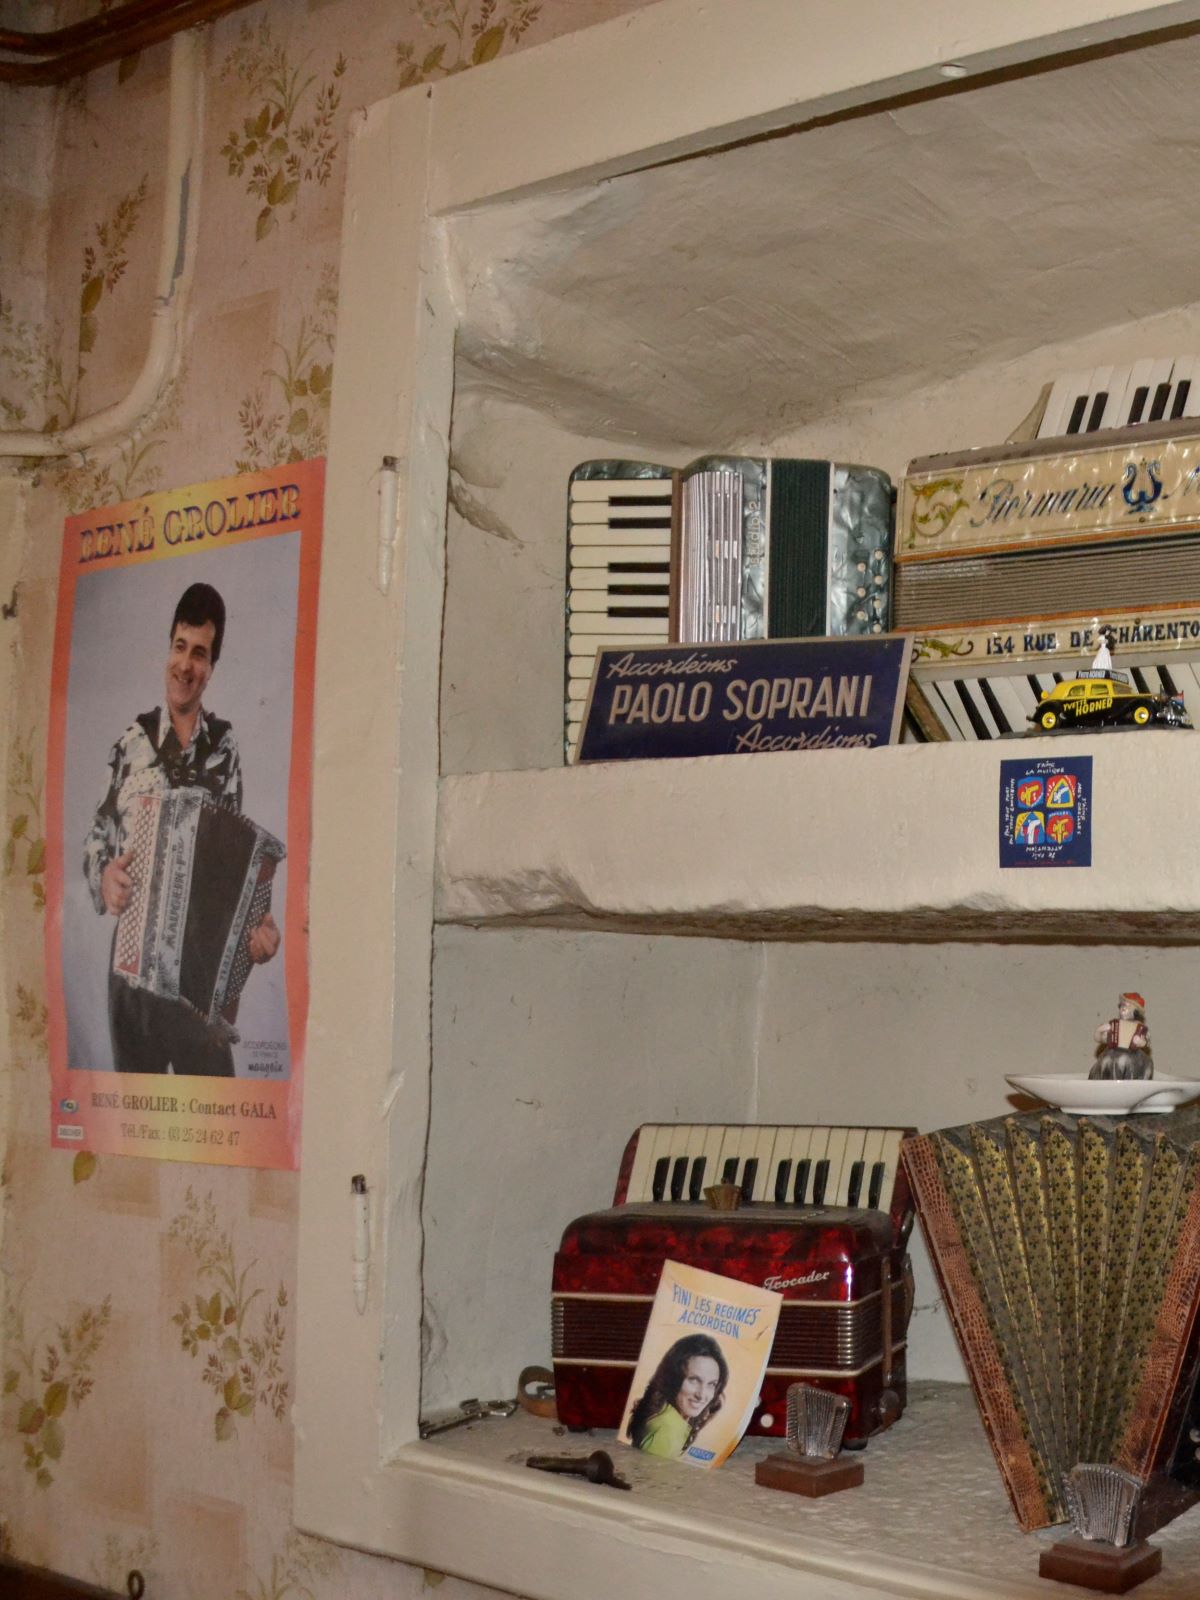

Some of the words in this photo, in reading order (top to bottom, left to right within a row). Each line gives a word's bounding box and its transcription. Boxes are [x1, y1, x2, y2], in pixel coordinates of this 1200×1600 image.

[79, 506, 155, 564] RENÉ
[987, 636, 1015, 655] 154
[1023, 632, 1057, 652] RUE
[1070, 629, 1093, 648] DE
[606, 652, 738, 679] Accordéons
[608, 681, 713, 725] PAOLO
[722, 674, 873, 721] SOPRANI
[1063, 697, 1088, 712] YVETTE
[1075, 698, 1113, 717] HORNER
[735, 723, 877, 752] Accordions
[91, 1091, 120, 1109] RENÉ
[122, 1095, 179, 1113] GROLIER
[189, 1098, 236, 1117] Contact
[240, 1102, 277, 1119] GALA
[168, 1126, 181, 1142] 03
[182, 1128, 194, 1143] 25
[209, 1129, 224, 1145] 62
[226, 1130, 241, 1146] 47
[762, 1270, 830, 1291] Trocader
[672, 1283, 692, 1306] FINI
[694, 1294, 711, 1313] LES
[714, 1303, 761, 1326] REGIMES
[678, 1309, 741, 1339] ACCORDEON
